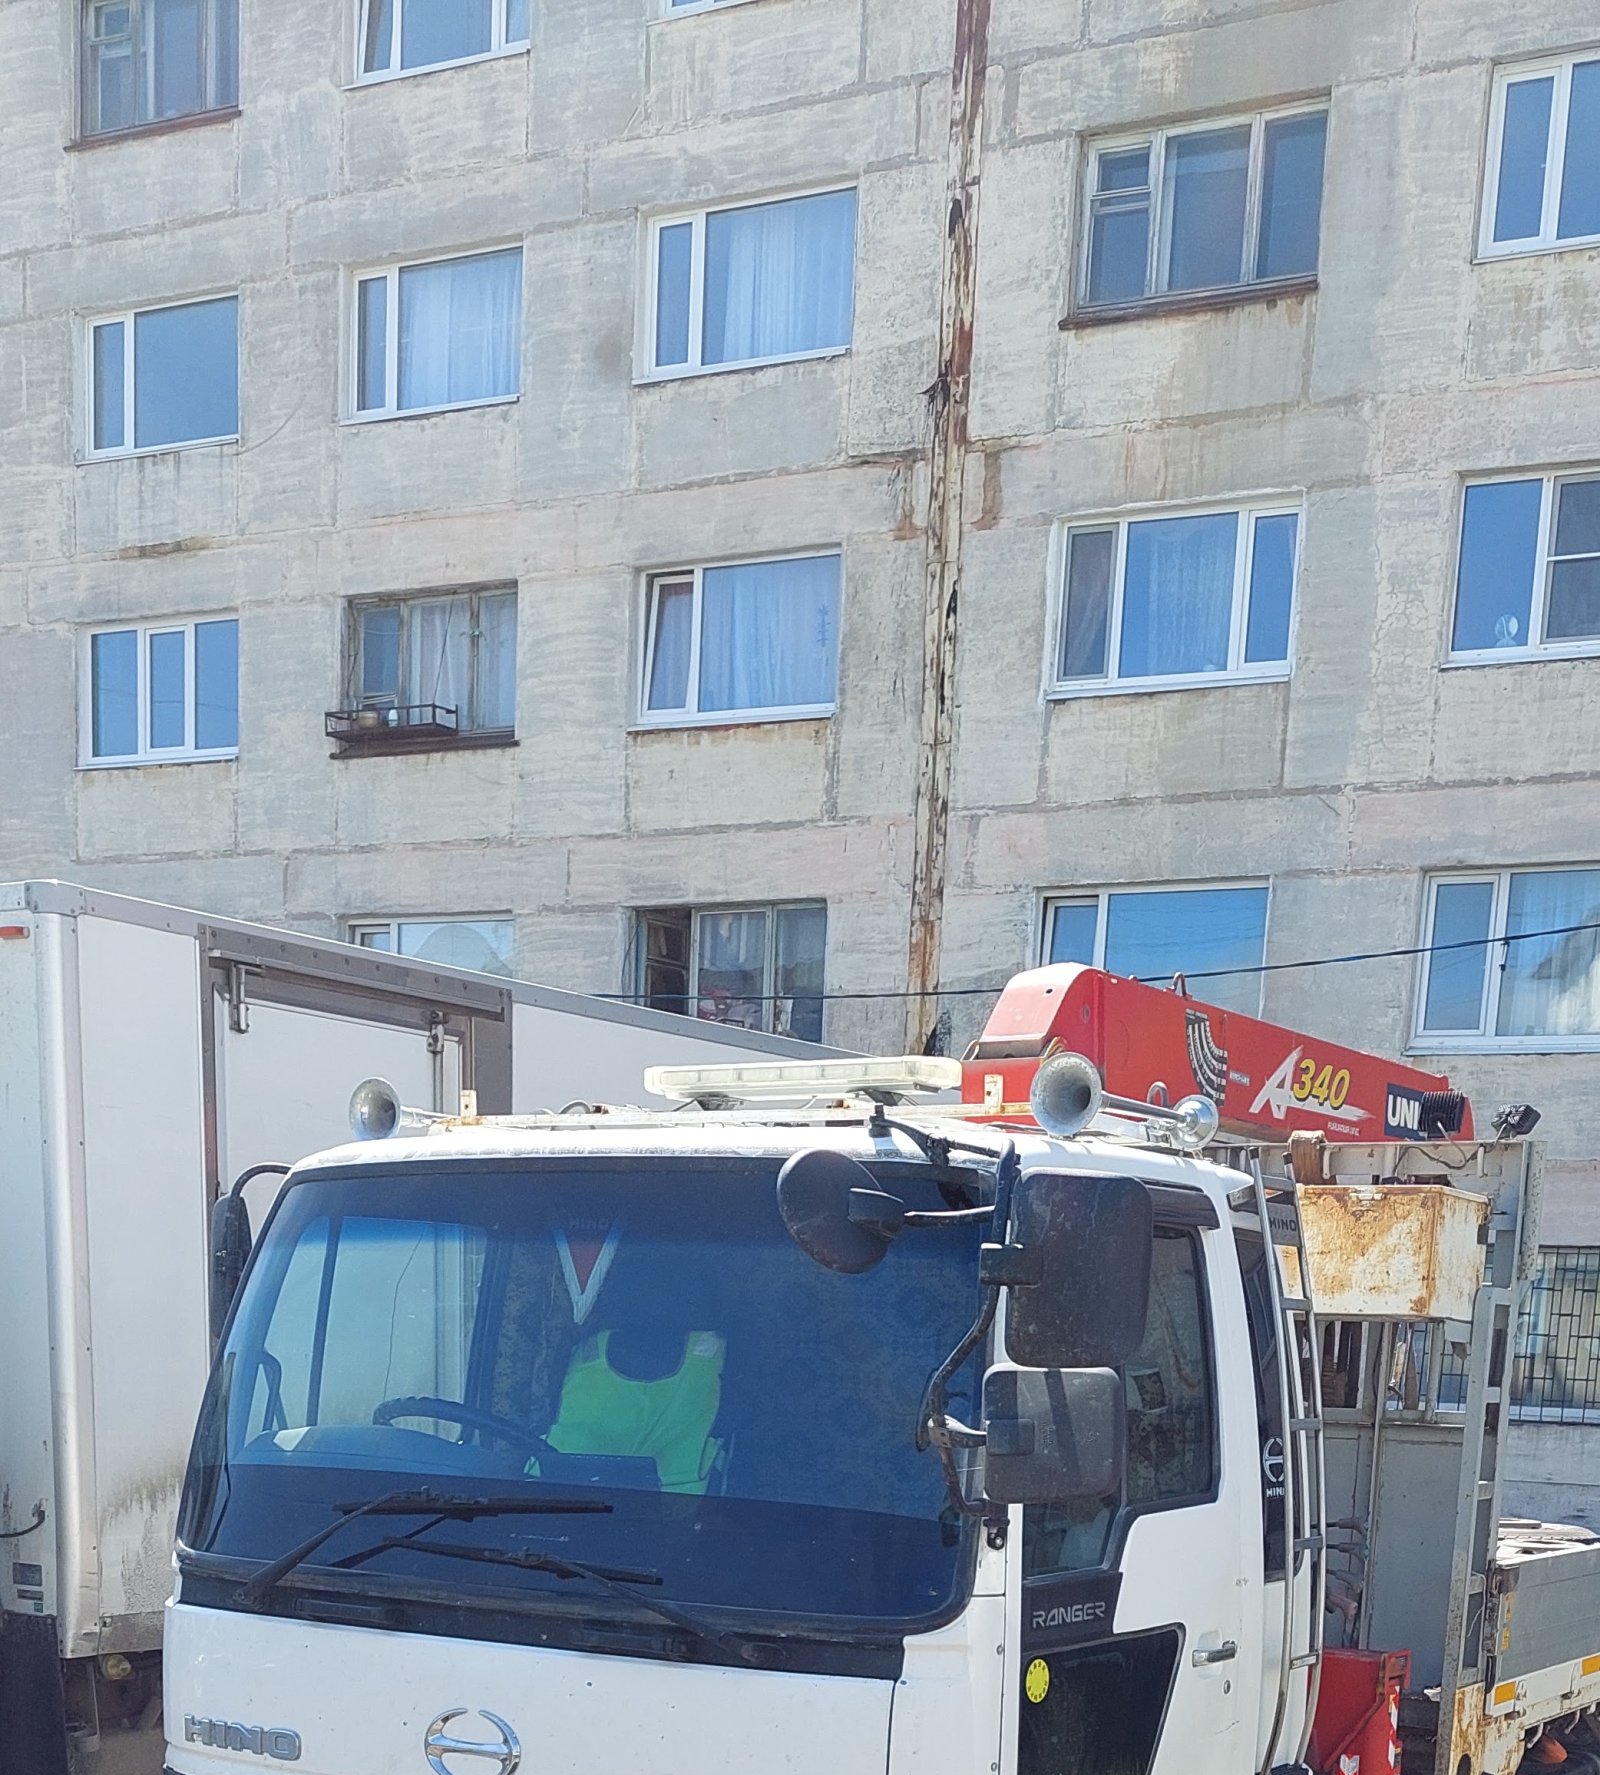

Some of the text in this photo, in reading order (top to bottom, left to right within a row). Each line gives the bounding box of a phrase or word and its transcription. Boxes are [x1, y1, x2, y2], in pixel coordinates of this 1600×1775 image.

[1388, 1094, 1420, 1131] UNI
[1269, 1216, 1297, 1231] HINO
[1266, 1487, 1285, 1498] HIN
[1033, 1602, 1105, 1628] RANGER
[184, 1713, 302, 1761] HINO
